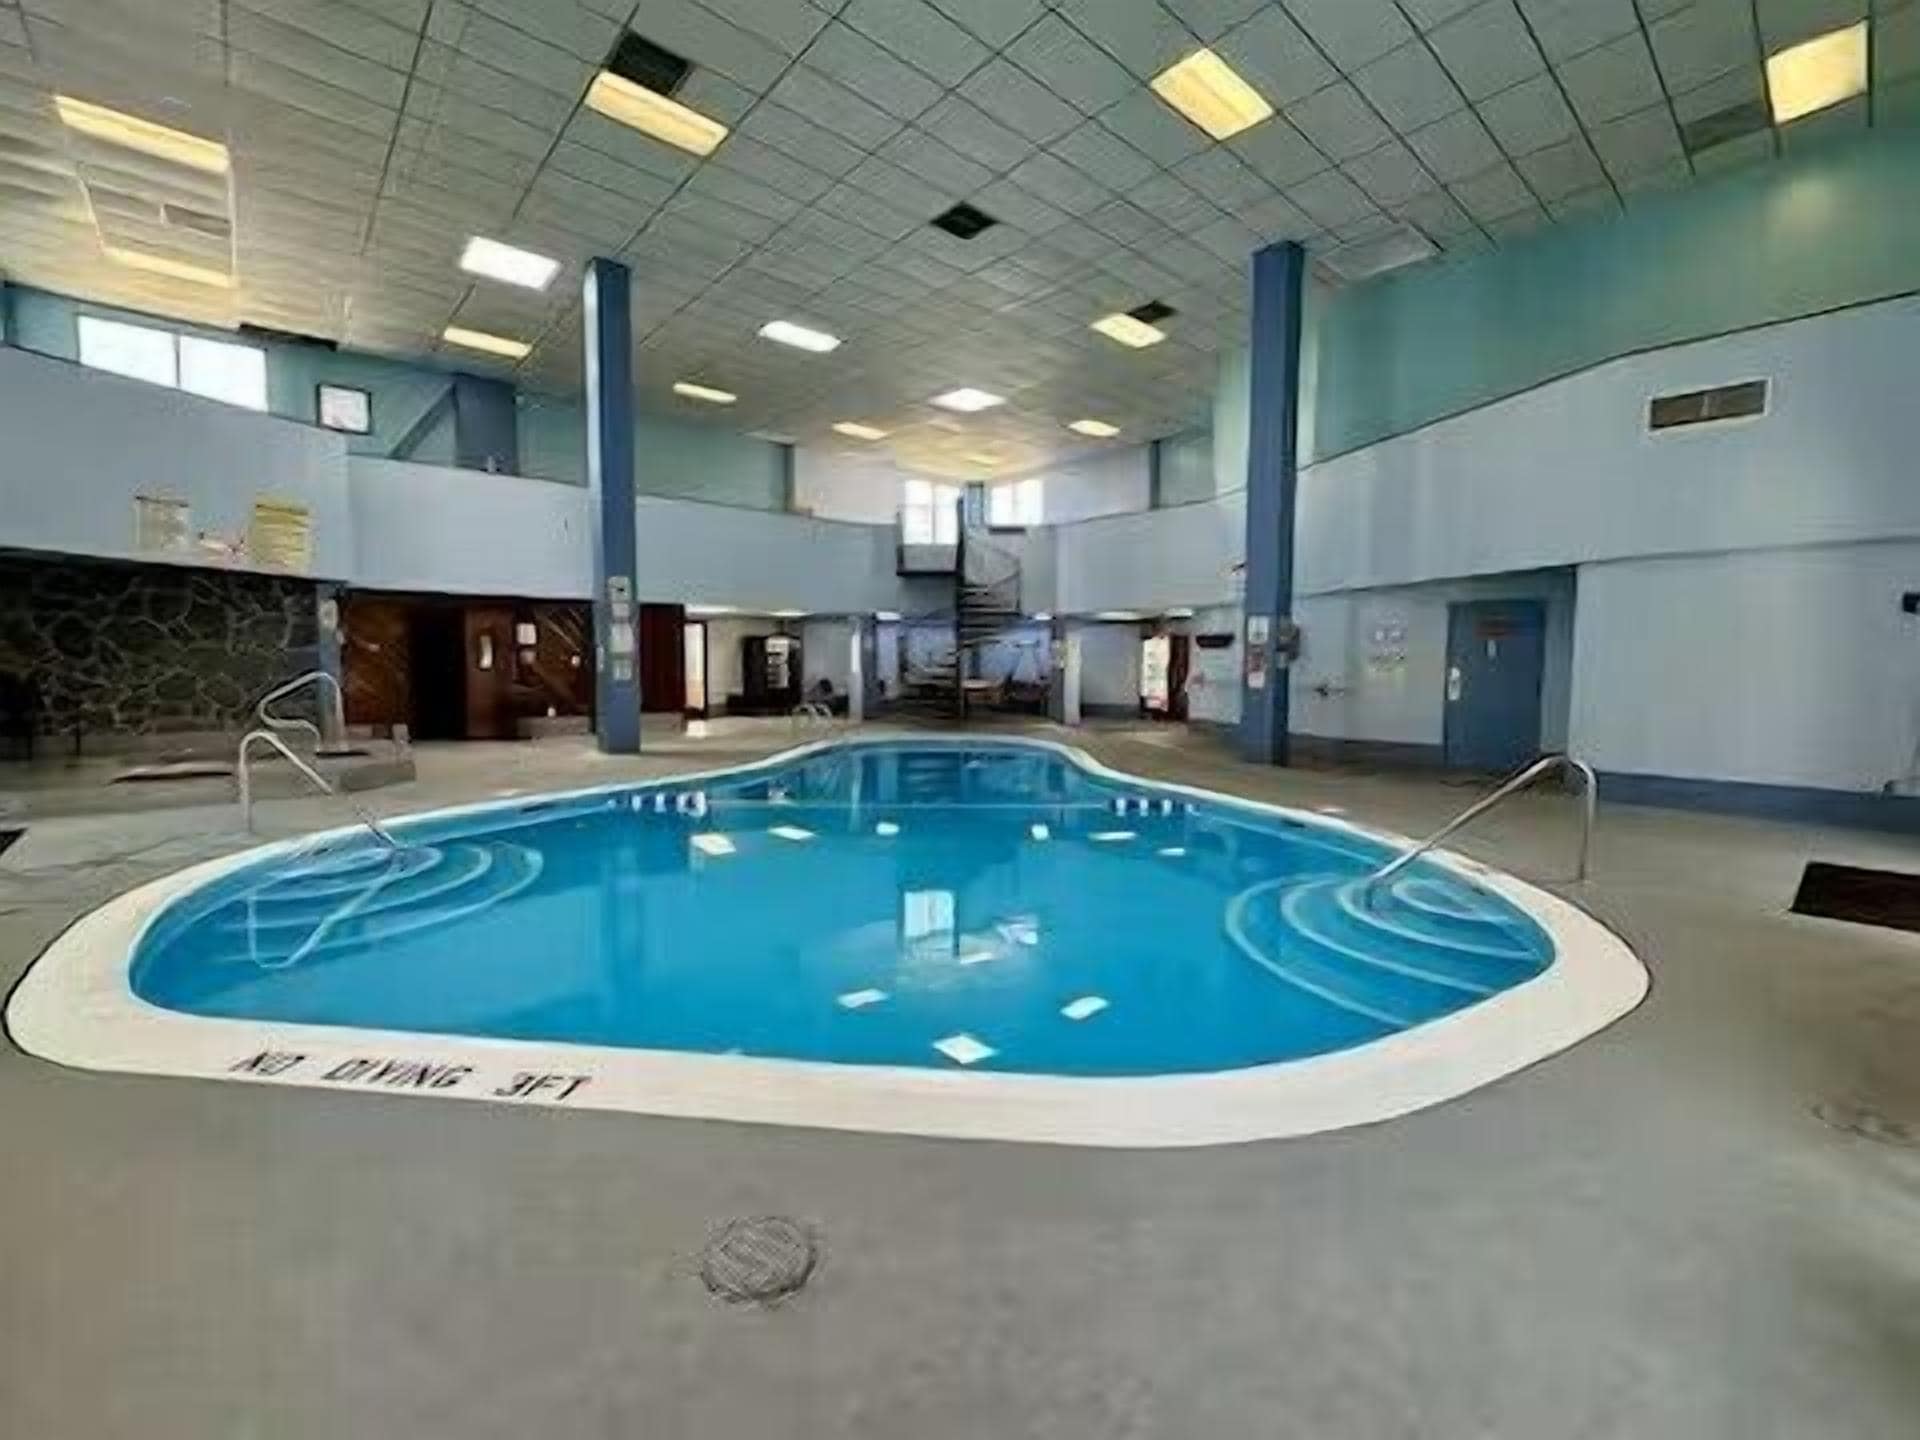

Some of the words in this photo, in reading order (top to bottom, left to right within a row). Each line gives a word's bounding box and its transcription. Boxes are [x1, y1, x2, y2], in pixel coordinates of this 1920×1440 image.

[229, 1052, 304, 1075] NO
[321, 1058, 473, 1088] DIVING
[494, 1072, 592, 1100] 3FT
